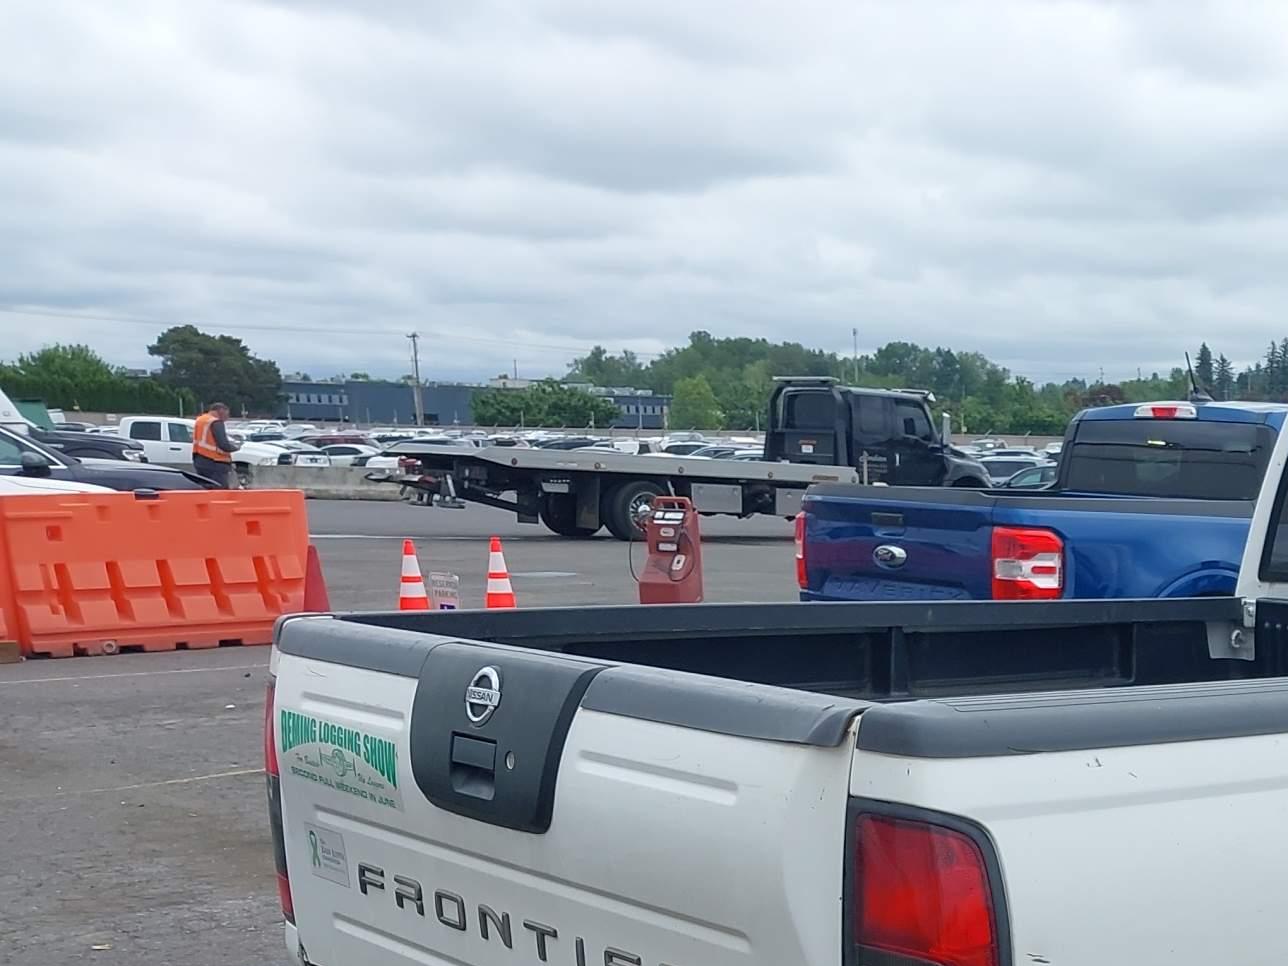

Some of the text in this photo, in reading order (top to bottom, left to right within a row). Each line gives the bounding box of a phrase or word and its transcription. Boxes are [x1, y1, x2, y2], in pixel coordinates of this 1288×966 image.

[281, 709, 317, 753] DEMING
[318, 720, 361, 758] LOGGING
[363, 734, 397, 791] SHOW
